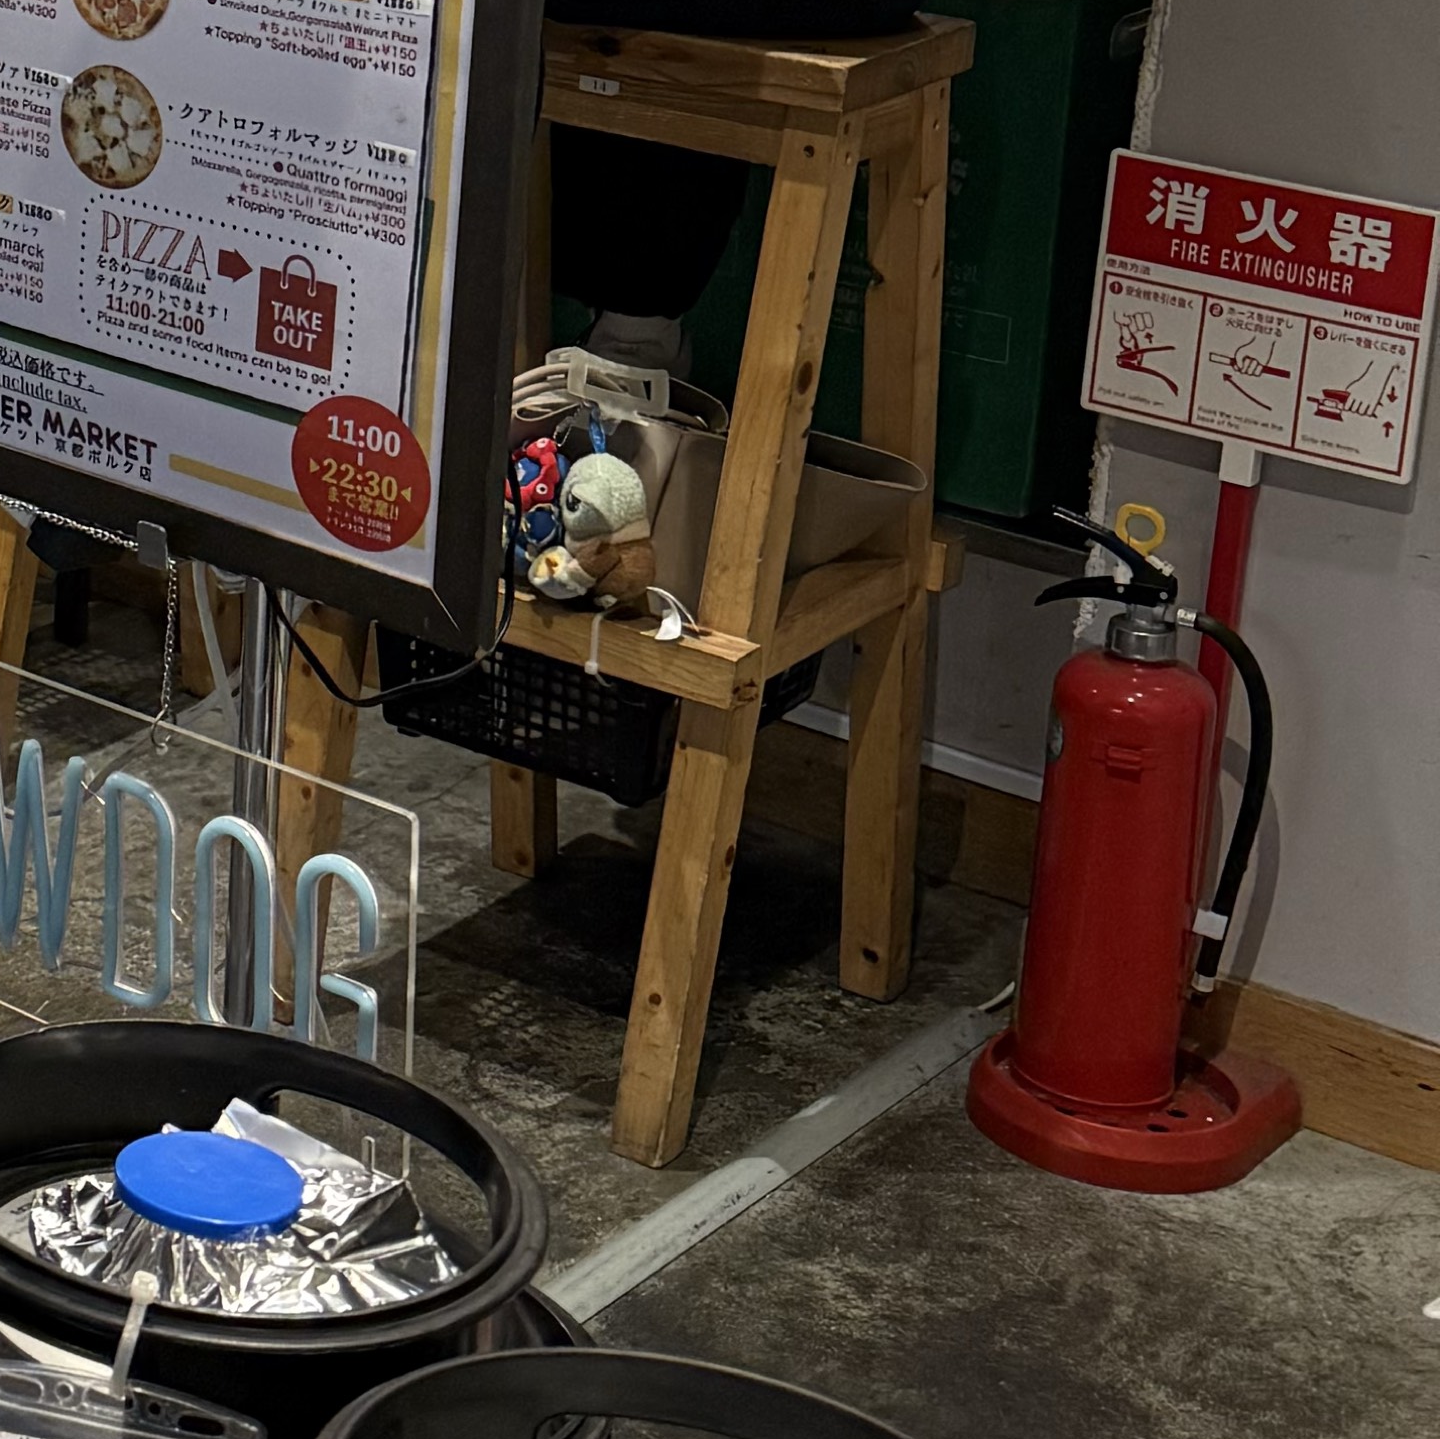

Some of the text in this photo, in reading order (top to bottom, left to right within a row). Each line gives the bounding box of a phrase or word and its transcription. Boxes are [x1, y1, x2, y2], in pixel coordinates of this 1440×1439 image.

[180, 102, 358, 155] クアトロフォルマッジ
[287, 163, 407, 202] Quattro formaggi
[100, 210, 211, 280] PIZZA
[1145, 176, 1392, 273] 消火器
[1171, 239, 1353, 296] FIRE EXTINGUISHER
[271, 301, 323, 332] TAKE
[1344, 308, 1371, 323] HOW
[1376, 313, 1392, 325] TO
[274, 325, 317, 353] OUT
[42, 409, 157, 465] MARKET
[328, 415, 400, 457] 11:00
[322, 458, 398, 501] 22:30
